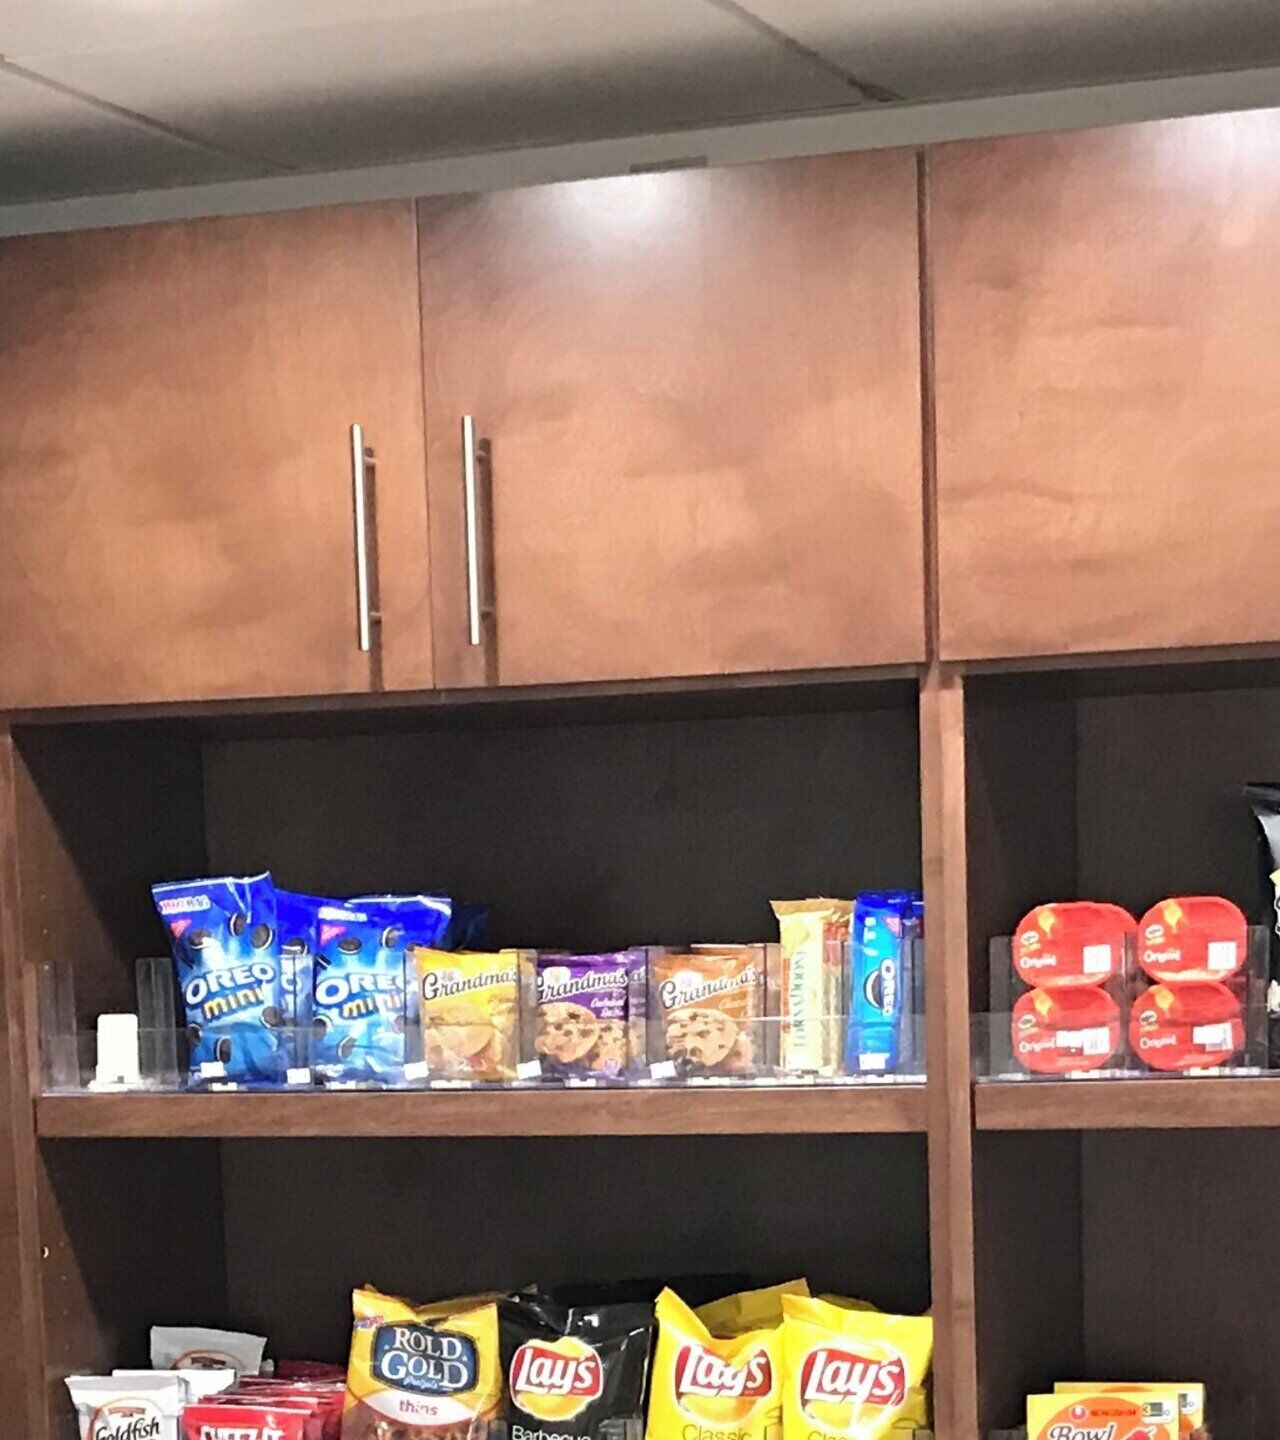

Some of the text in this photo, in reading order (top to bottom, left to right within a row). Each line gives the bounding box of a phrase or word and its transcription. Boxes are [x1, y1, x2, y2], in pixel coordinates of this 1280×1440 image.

[186, 961, 274, 1006] OREO
[203, 983, 266, 1021] mini
[393, 1326, 463, 1360] ROLD
[381, 1349, 469, 1389] GOLD
